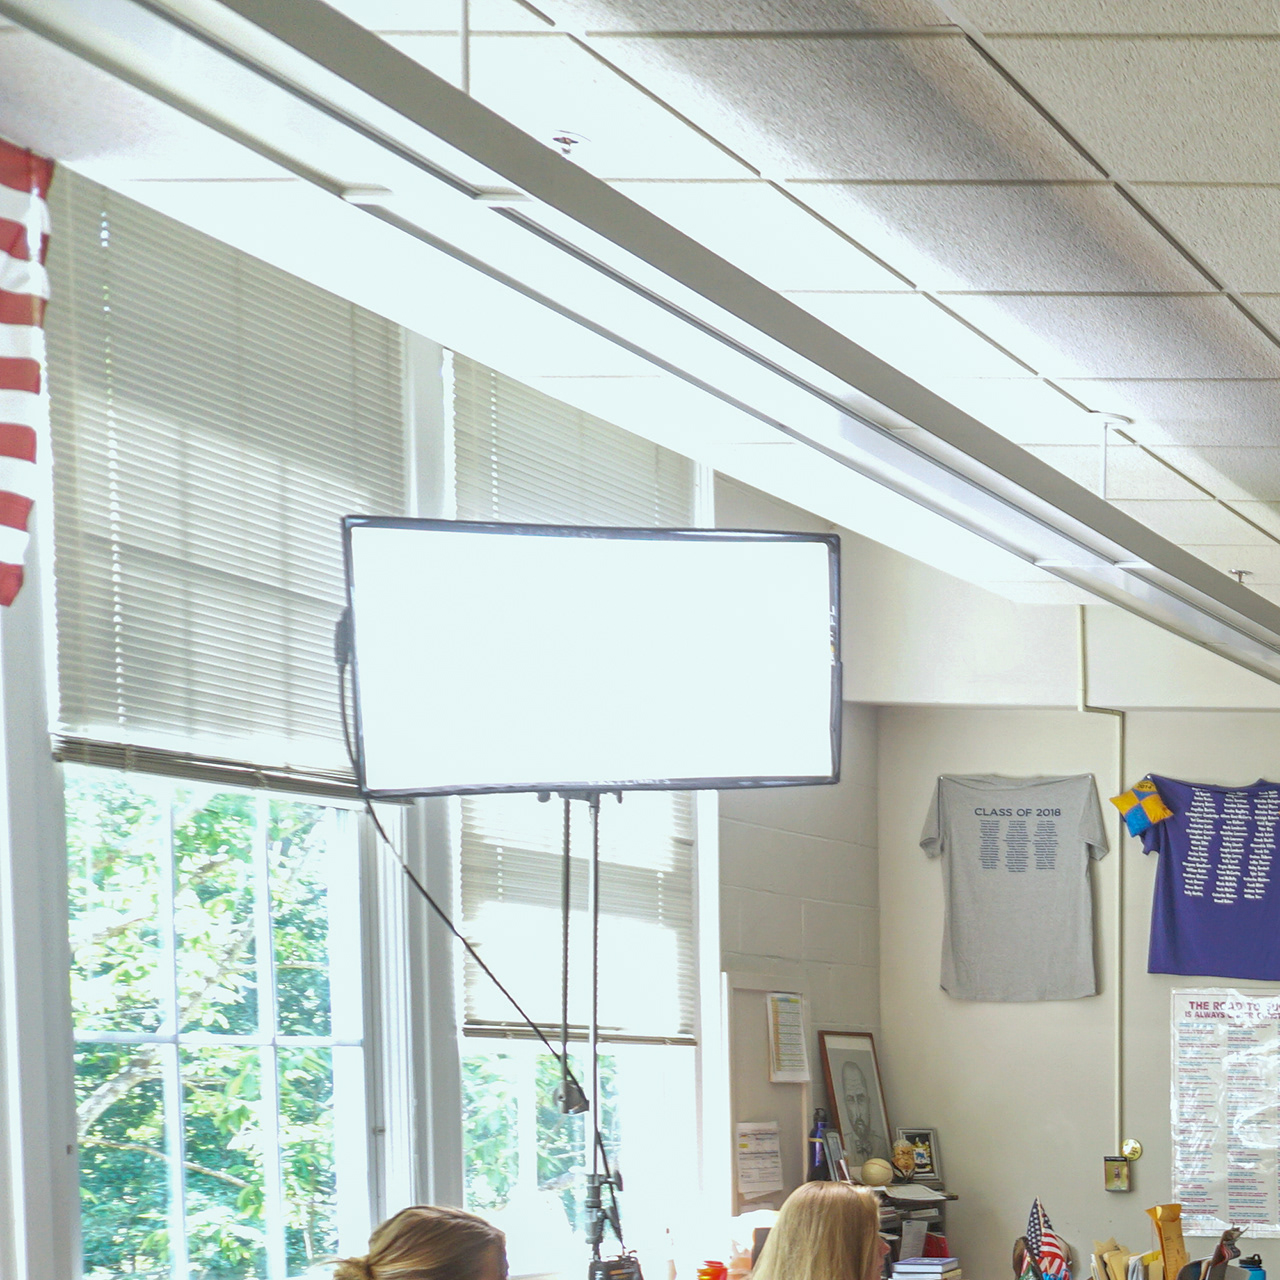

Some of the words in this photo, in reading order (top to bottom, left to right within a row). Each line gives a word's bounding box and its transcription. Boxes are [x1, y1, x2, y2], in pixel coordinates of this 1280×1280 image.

[974, 807, 1012, 816] CLASS
[1016, 808, 1032, 817] OF
[1036, 808, 1061, 817] 2018
[1189, 1001, 1209, 1010] THE
